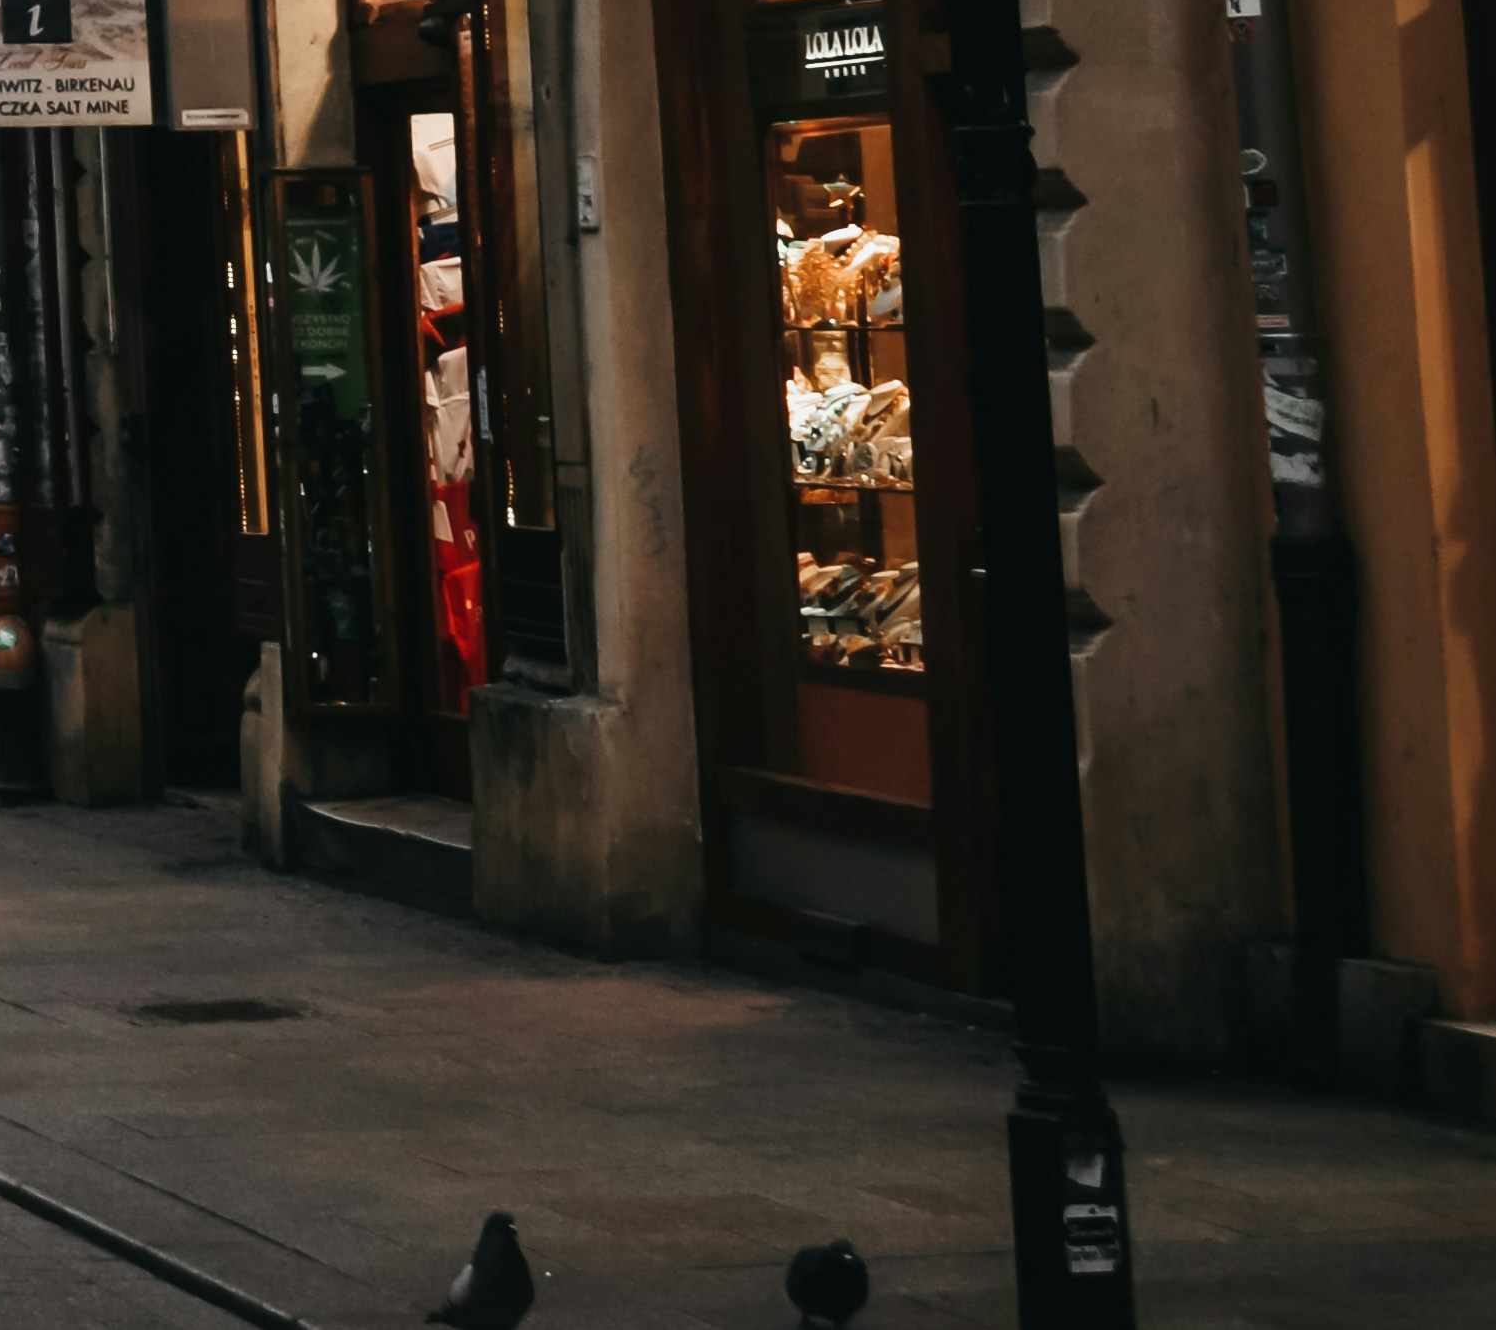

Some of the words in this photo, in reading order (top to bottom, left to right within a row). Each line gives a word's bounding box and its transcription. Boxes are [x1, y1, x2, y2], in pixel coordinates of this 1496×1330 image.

[55, 77, 135, 92] BIRKENAU
[47, 100, 80, 115] SALT
[87, 100, 129, 114] MINE
